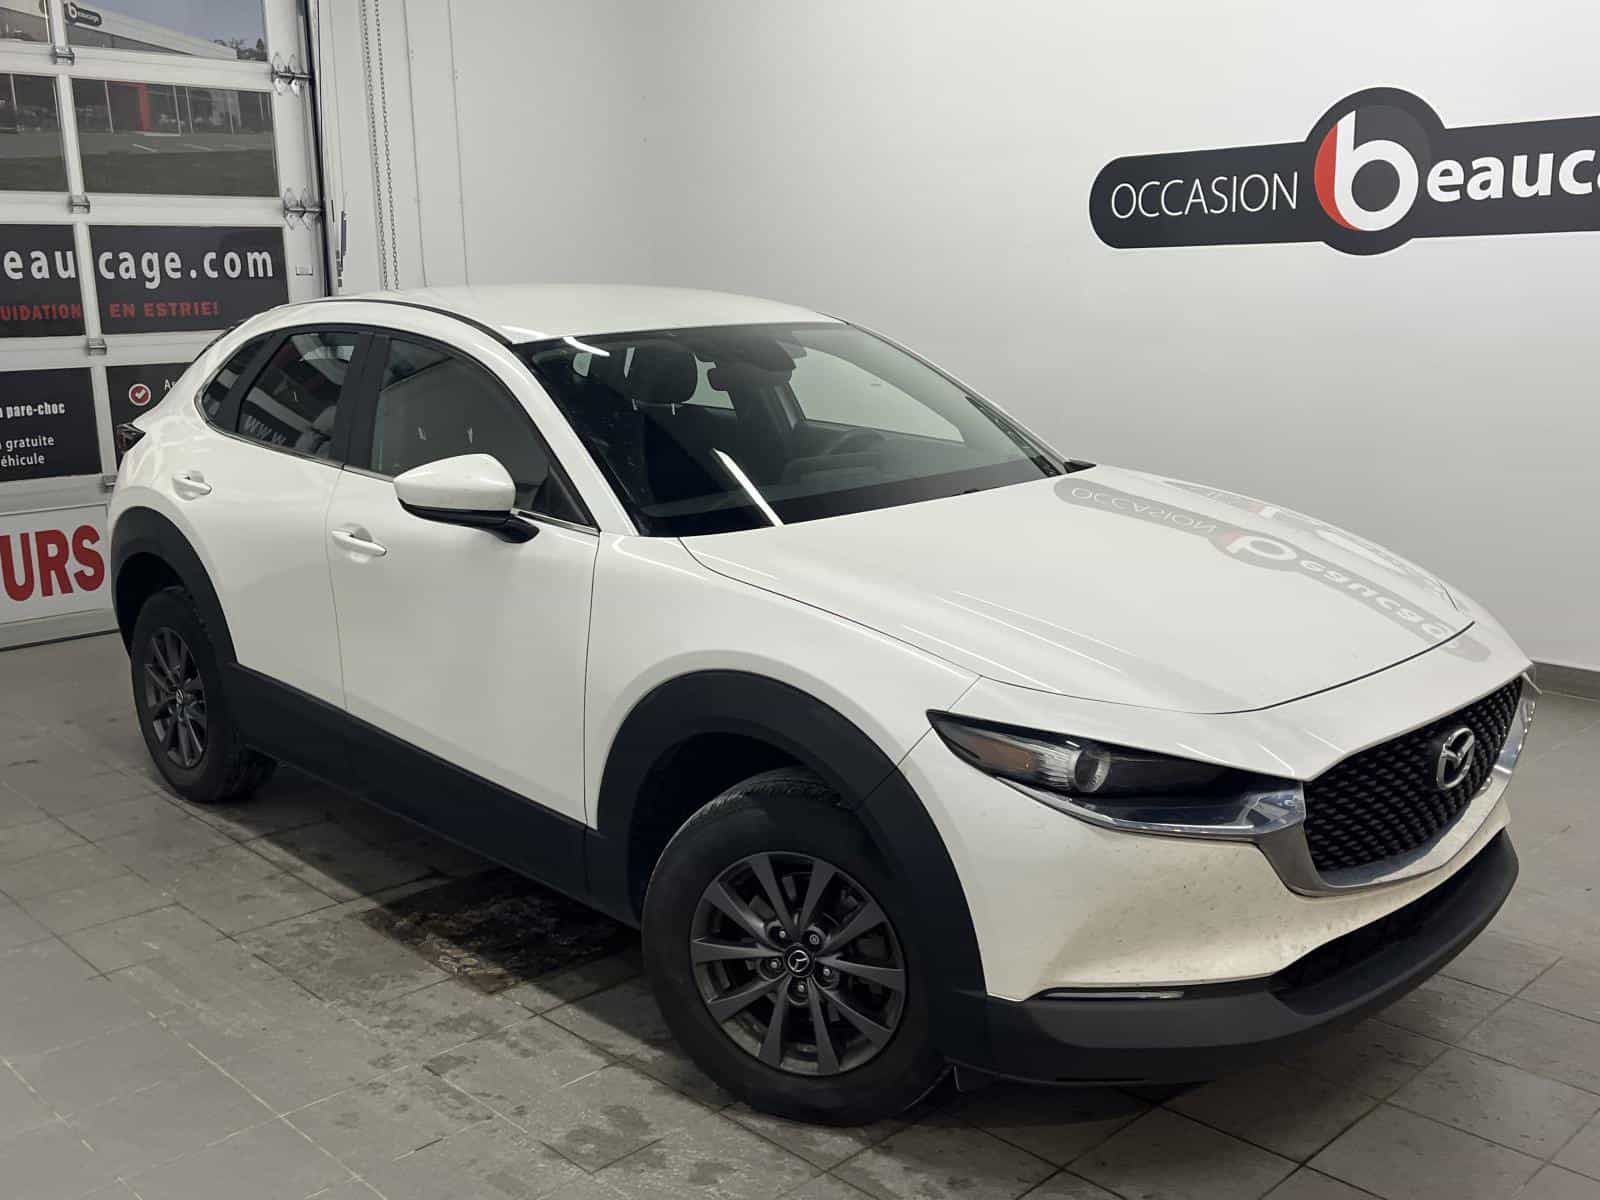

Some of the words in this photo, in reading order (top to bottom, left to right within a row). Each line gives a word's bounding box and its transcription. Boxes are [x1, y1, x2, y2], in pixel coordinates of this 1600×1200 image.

[1110, 171, 1299, 219] OCCASION
[1333, 110, 1600, 232] beauc
[109, 303, 136, 318] EN
[143, 301, 219, 318] ESTRIE!
[6, 402, 65, 419] pare-choc
[6, 435, 55, 452] gratuite
[0, 525, 105, 601] URS
